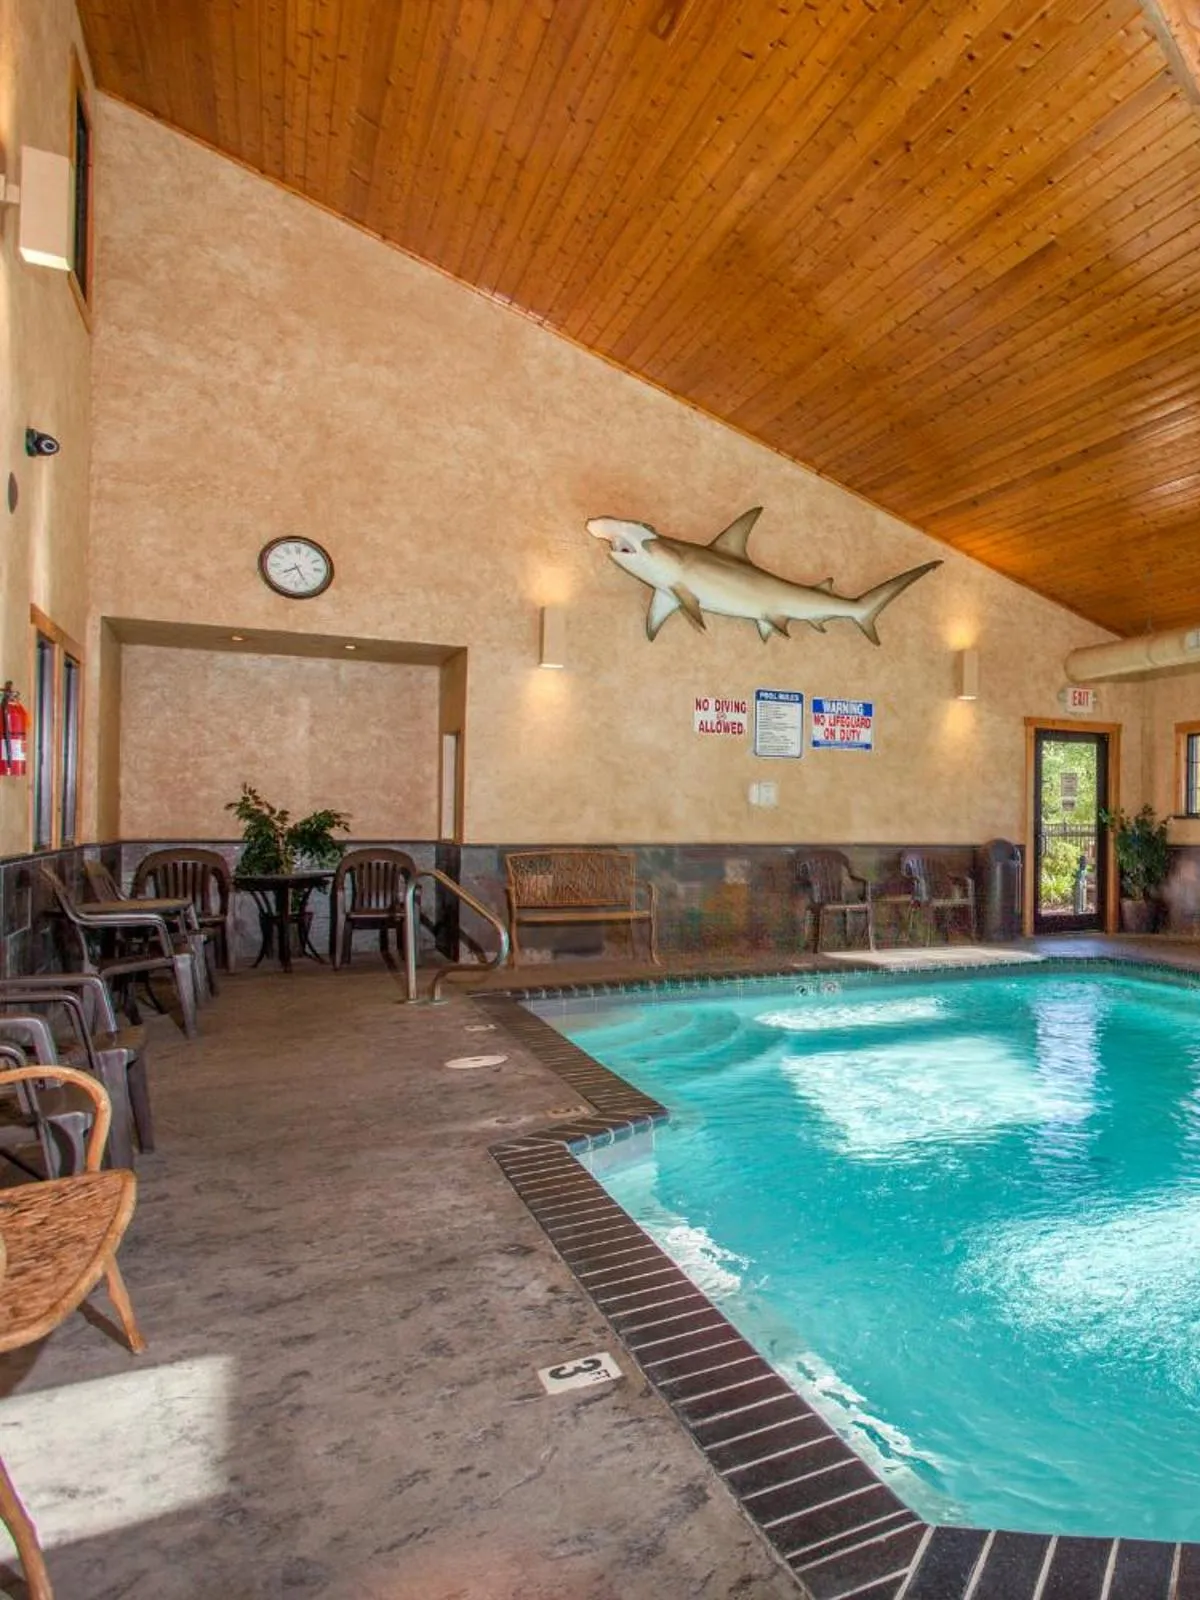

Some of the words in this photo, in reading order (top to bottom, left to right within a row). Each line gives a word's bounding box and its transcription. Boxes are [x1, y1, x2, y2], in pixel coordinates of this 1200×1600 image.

[695, 698, 709, 711] NO
[715, 699, 747, 714] DIVING
[1072, 690, 1089, 706] EXIT
[823, 700, 864, 715] WARNING
[699, 719, 743, 735] ALLOWED
[814, 714, 825, 726] NO
[828, 714, 871, 729] LIFEGUARD
[824, 728, 836, 740] ON
[840, 729, 861, 741] DUTY
[549, 1359, 602, 1380] 3
